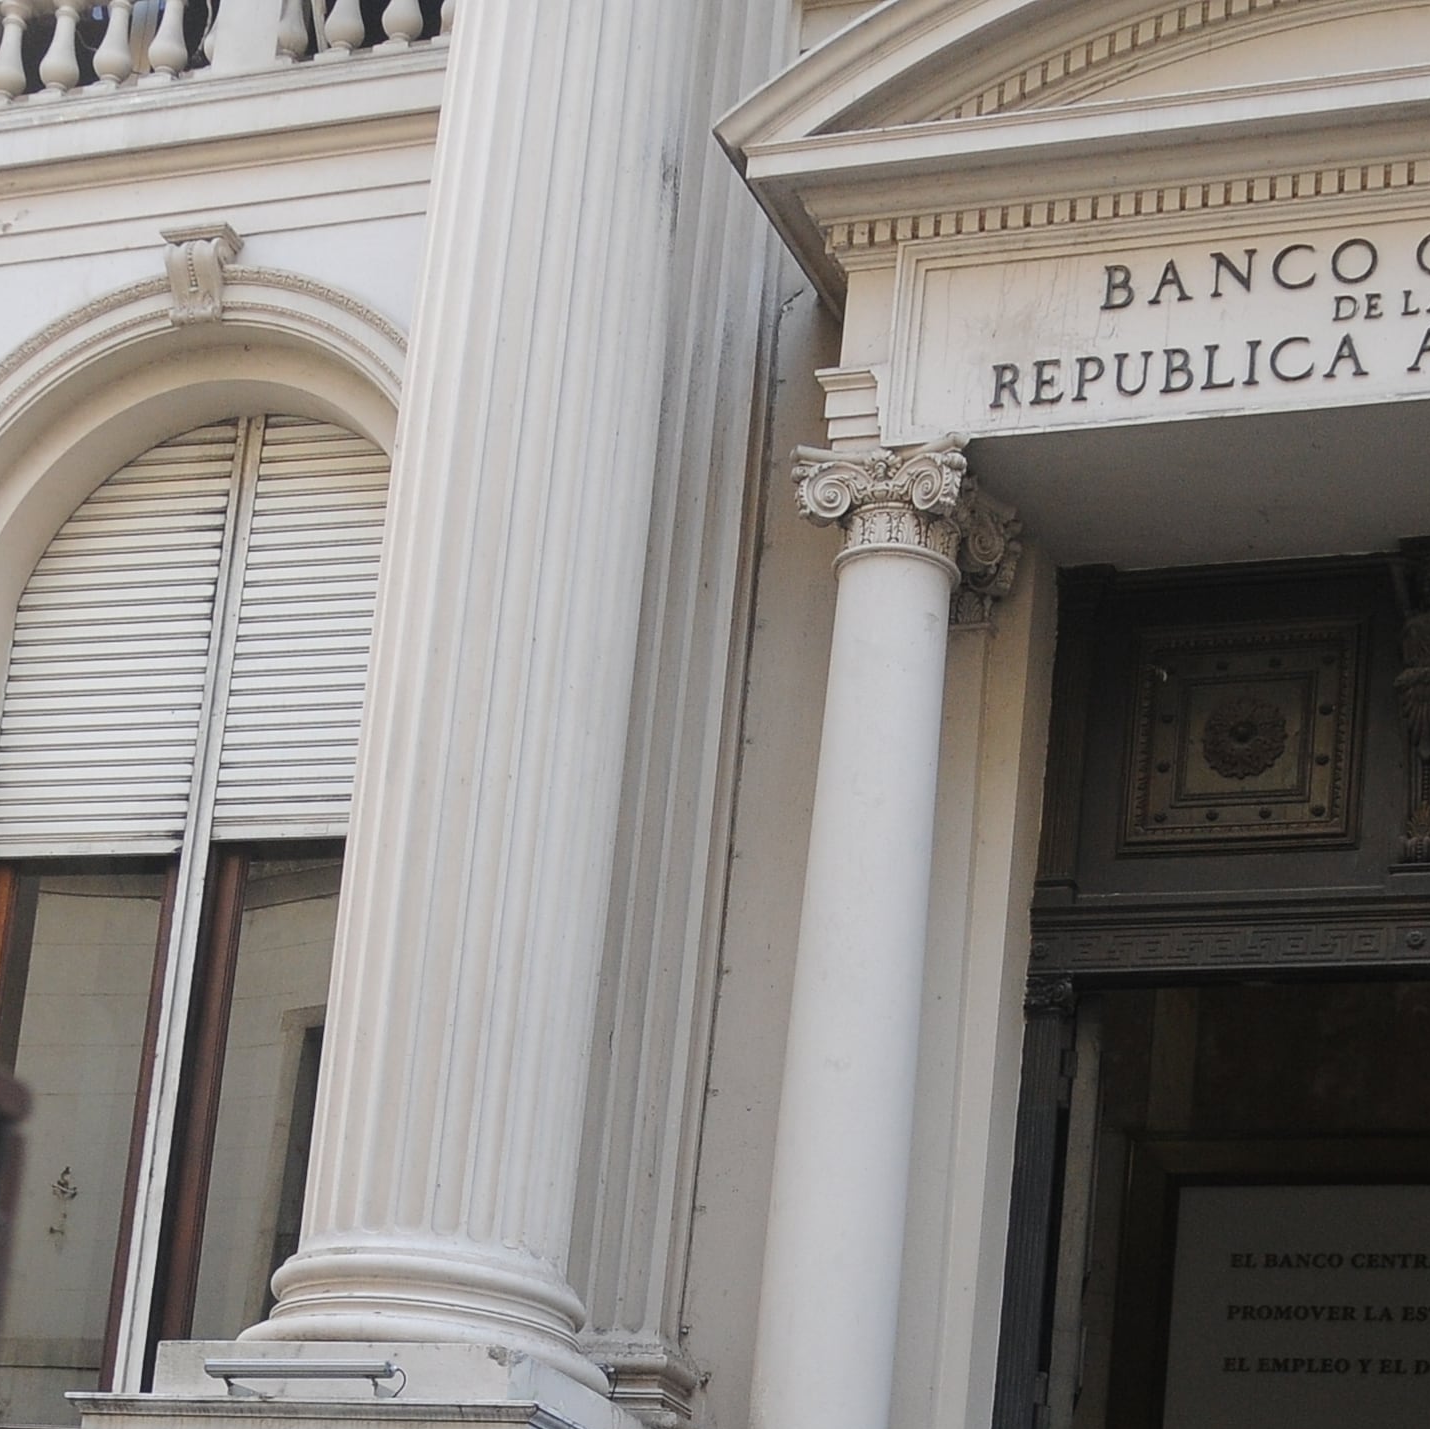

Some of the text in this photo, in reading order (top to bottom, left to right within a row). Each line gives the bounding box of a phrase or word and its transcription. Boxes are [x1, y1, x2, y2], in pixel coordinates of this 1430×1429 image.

[1100, 237, 1380, 312] BANCO
[1331, 292, 1384, 322] DE
[988, 332, 1371, 409] REPUBLICA
[1230, 1253, 1258, 1269] EL
[1263, 1252, 1344, 1269] BANCO
[1226, 1304, 1357, 1321] PROMOVER
[1362, 1306, 1394, 1322] LA
[1222, 1357, 1251, 1373] EL
[1256, 1357, 1351, 1374] EMPLEO
[1357, 1358, 1372, 1375] Y
[1378, 1358, 1407, 1375] EL
